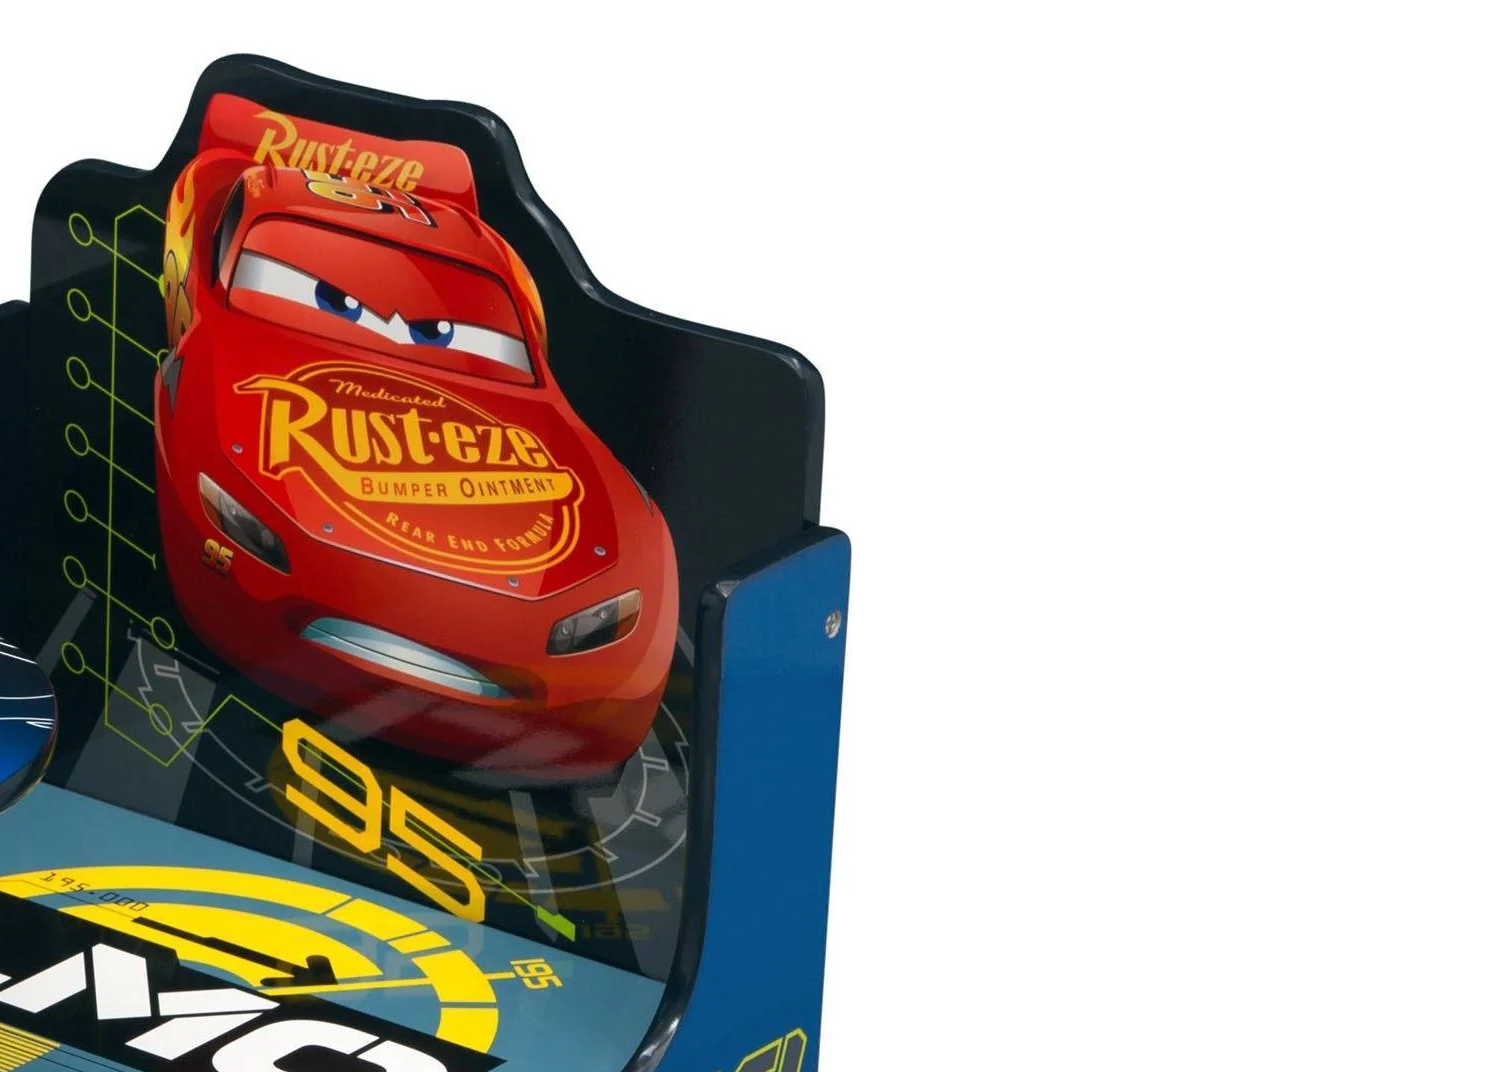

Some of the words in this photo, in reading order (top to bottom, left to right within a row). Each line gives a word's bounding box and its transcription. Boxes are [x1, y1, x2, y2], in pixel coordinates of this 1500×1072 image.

[328, 378, 448, 409] Medicated
[385, 511, 436, 543] REAR
[446, 534, 489, 553] END
[282, 717, 487, 924] 95
[510, 957, 563, 990] 195
